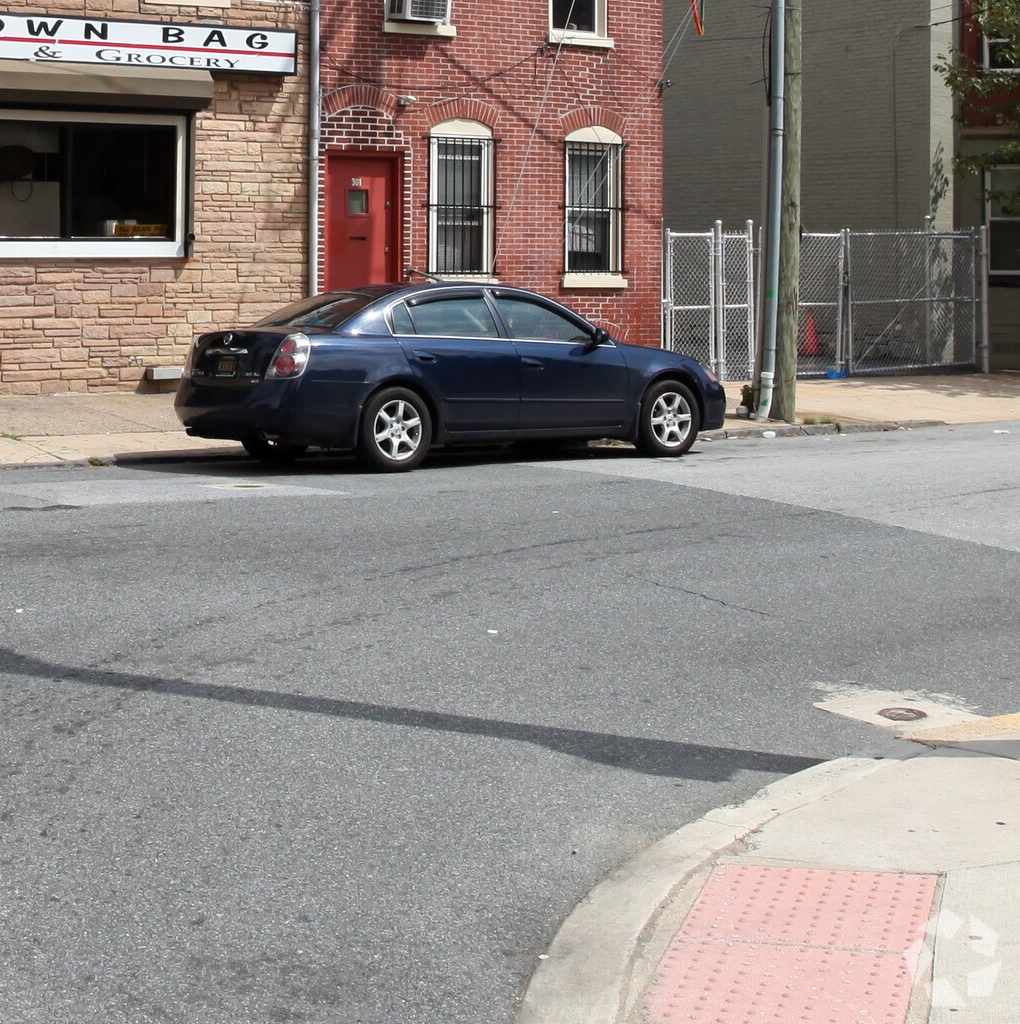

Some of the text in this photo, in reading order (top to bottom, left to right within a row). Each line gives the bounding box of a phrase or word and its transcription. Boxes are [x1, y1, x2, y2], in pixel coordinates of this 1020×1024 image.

[161, 26, 269, 50] BAG
[33, 45, 63, 60] &
[351, 178, 362, 187] 301
